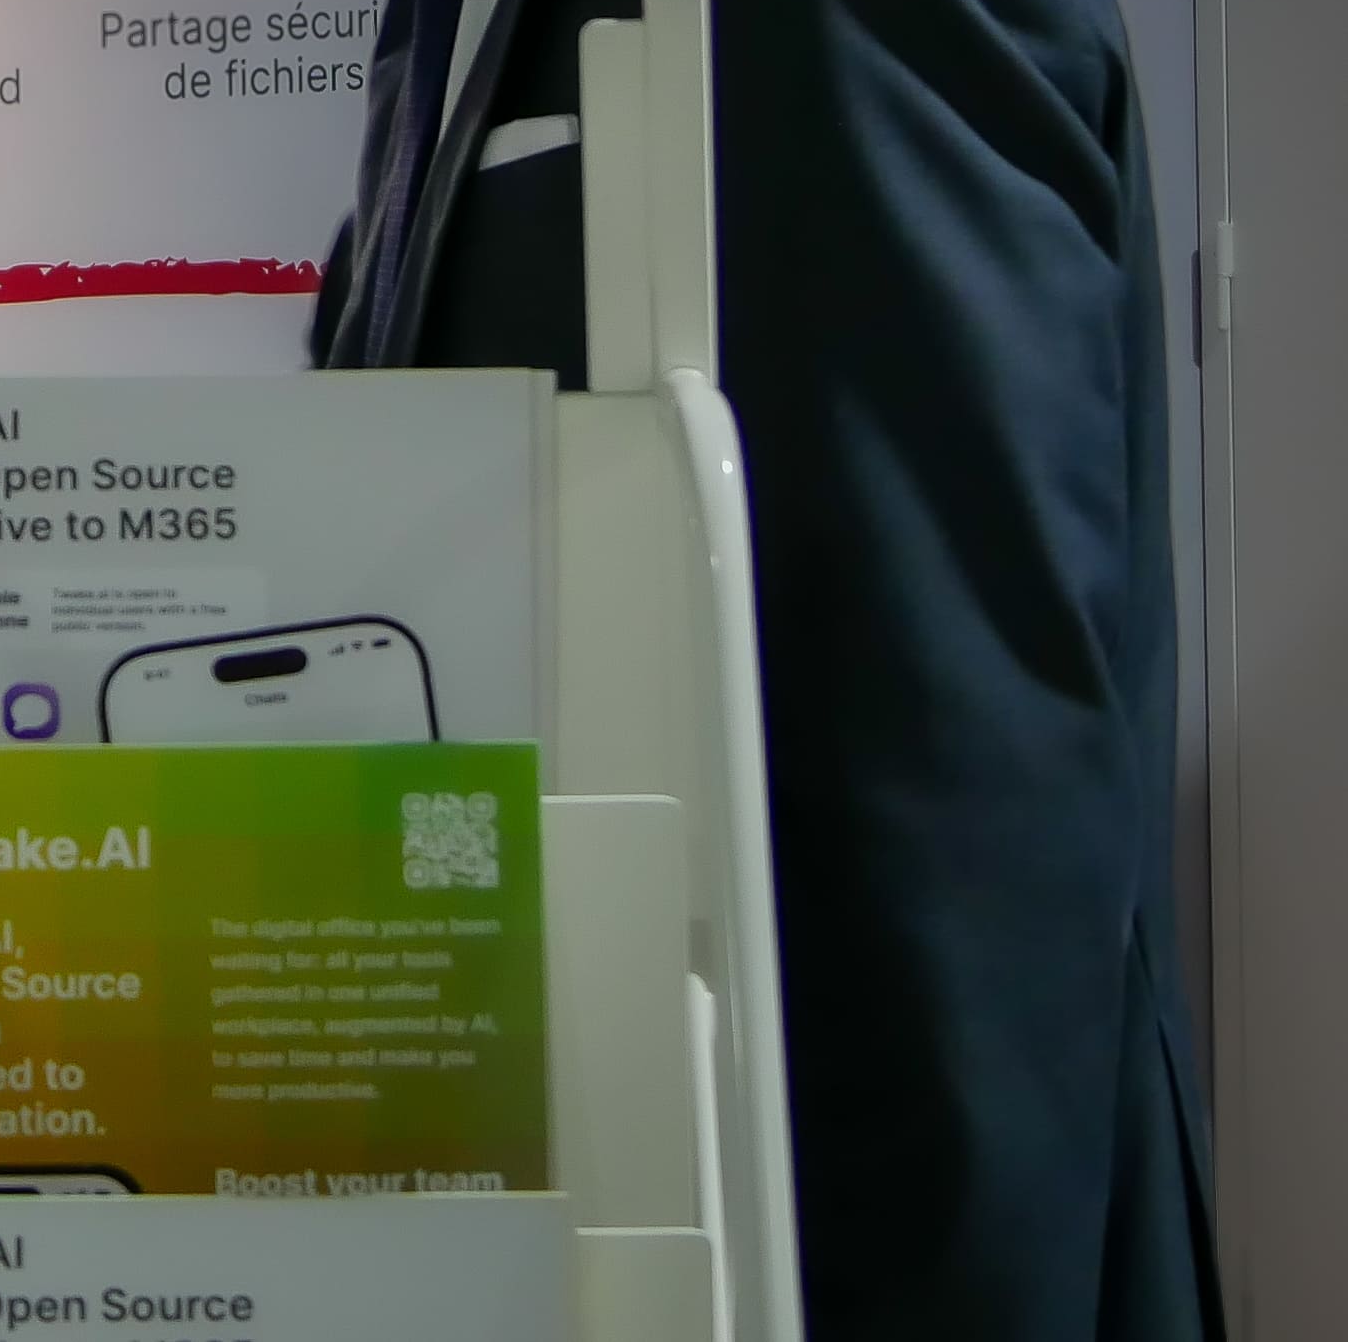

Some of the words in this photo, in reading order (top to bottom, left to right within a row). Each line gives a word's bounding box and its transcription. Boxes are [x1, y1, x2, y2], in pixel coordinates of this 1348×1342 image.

[101, 11, 251, 54] Partage
[266, 0, 378, 41] sécuri
[164, 62, 211, 99] de
[225, 56, 365, 97] fichiers
[92, 457, 235, 491] Source
[66, 510, 105, 541] to
[118, 506, 238, 541] M365
[211, 917, 248, 938] The
[252, 918, 313, 942] digital
[316, 916, 376, 938] office
[1, 965, 143, 1001] Source
[45, 1058, 86, 1092] to
[214, 1167, 320, 1196] Boost
[326, 1171, 406, 1195] your
[414, 1167, 504, 1193] team
[102, 1287, 255, 1323] Source
